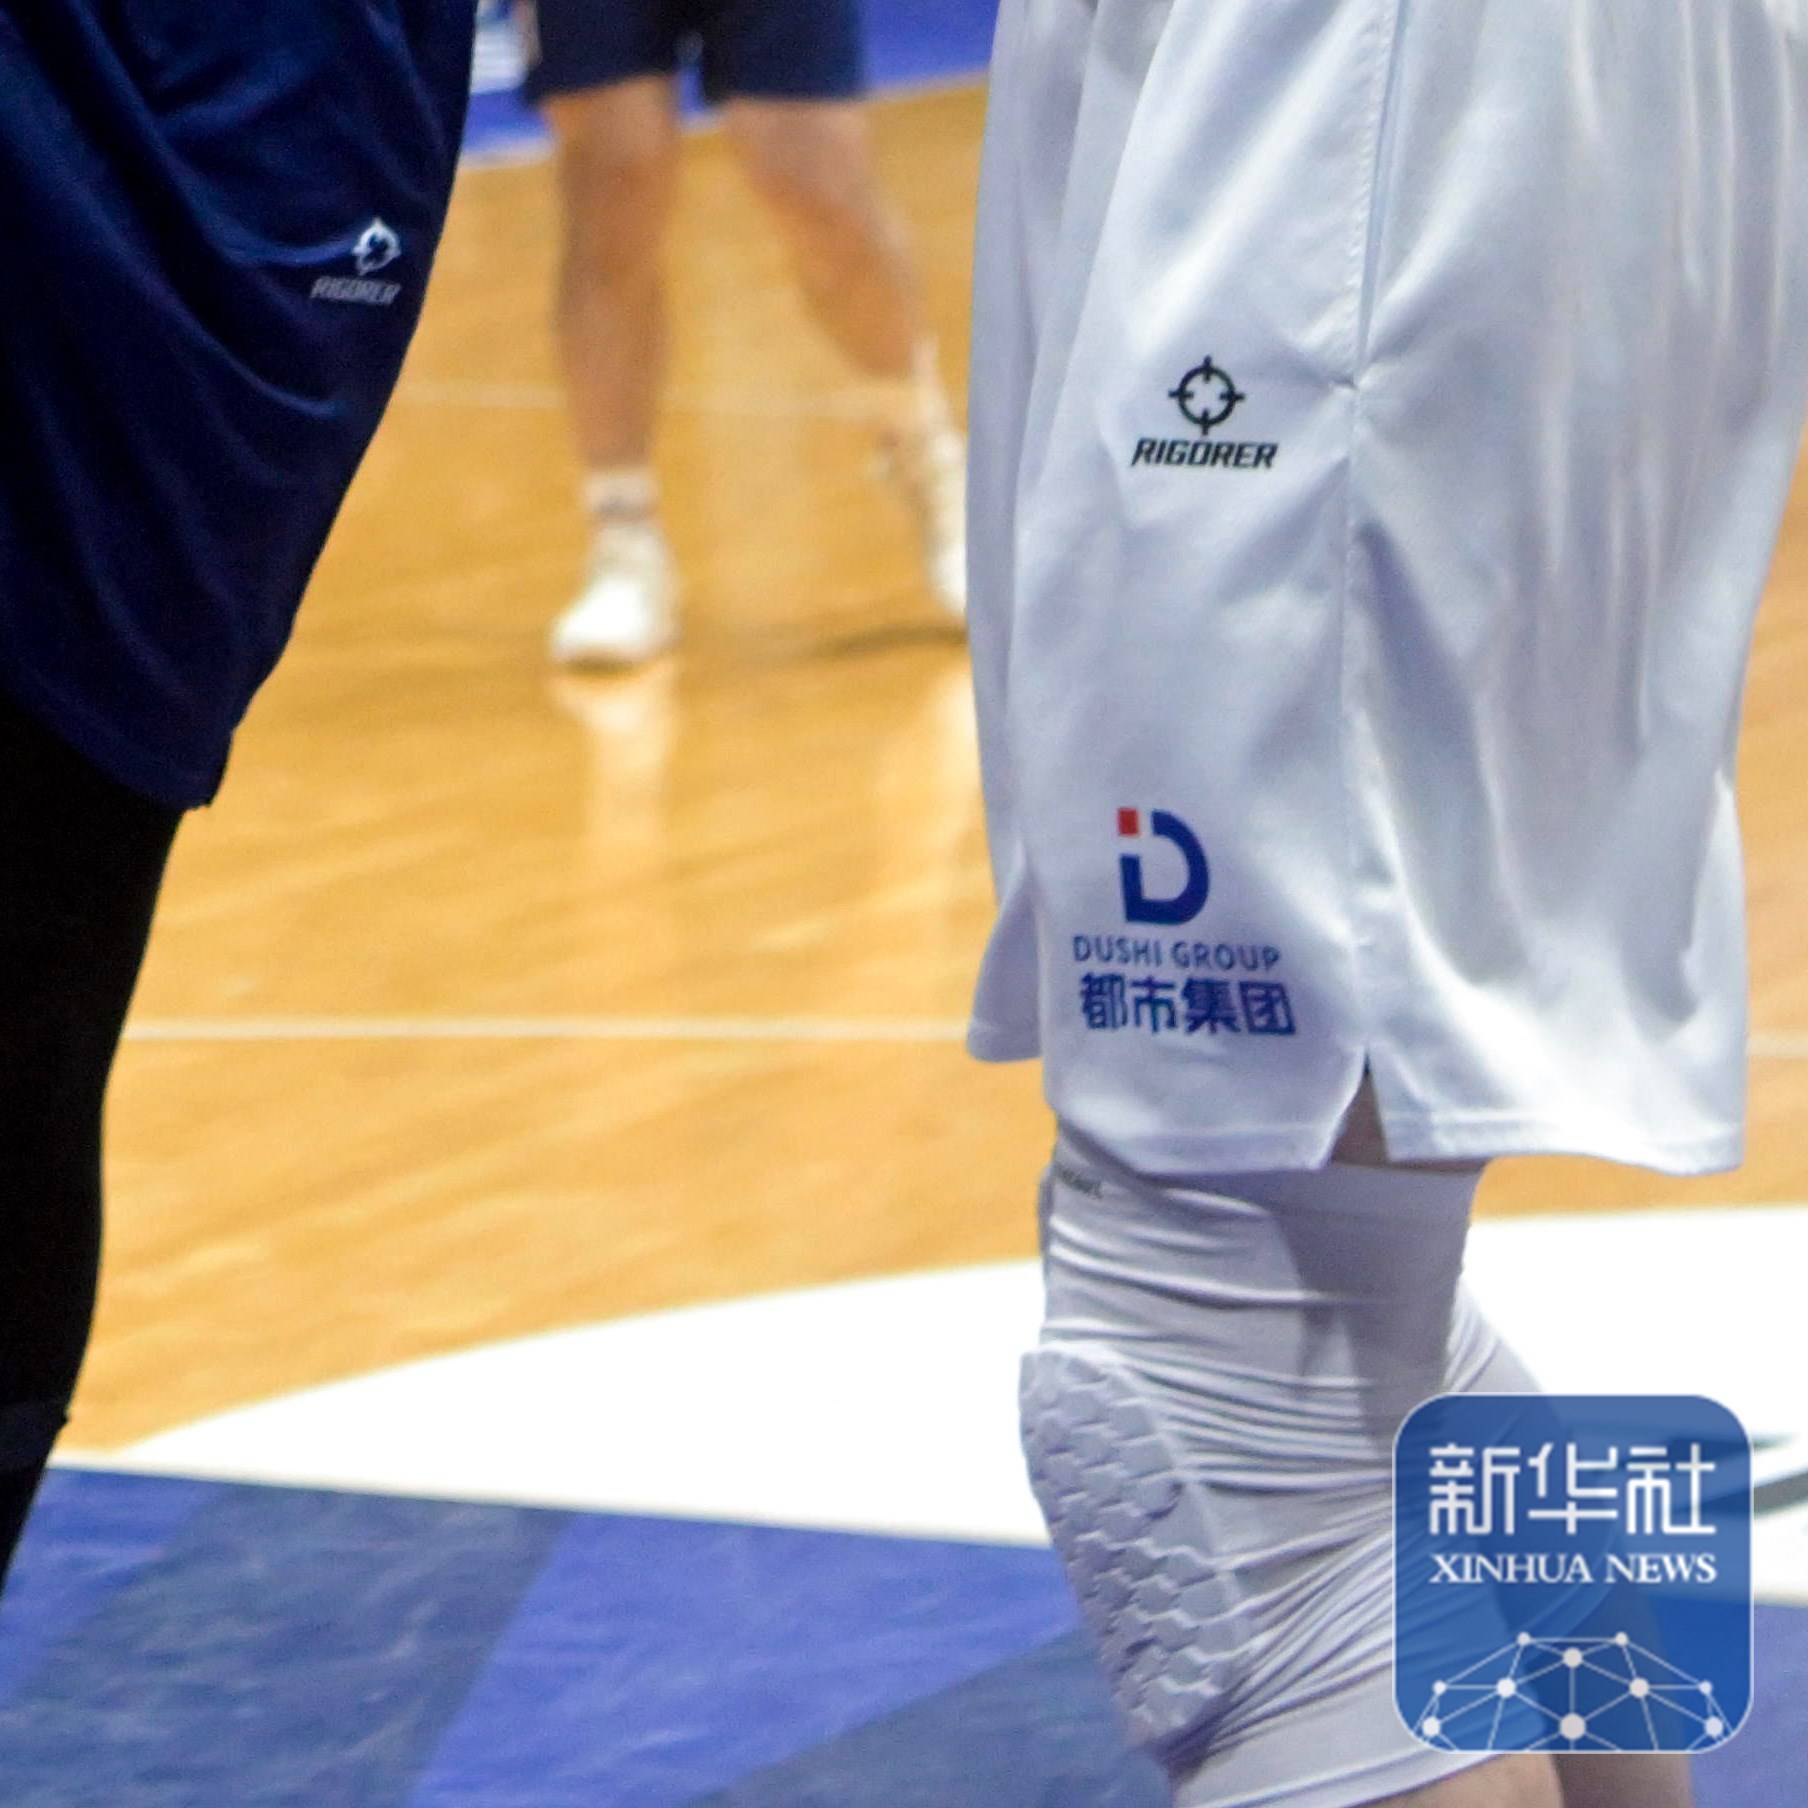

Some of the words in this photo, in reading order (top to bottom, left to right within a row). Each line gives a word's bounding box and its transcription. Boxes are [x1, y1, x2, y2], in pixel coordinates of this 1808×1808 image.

[1131, 437, 1279, 469] RIGORER
[1073, 935, 1162, 966] DUSHI
[1170, 940, 1281, 972] GROUP
[1080, 972, 1296, 1036] 都市集团
